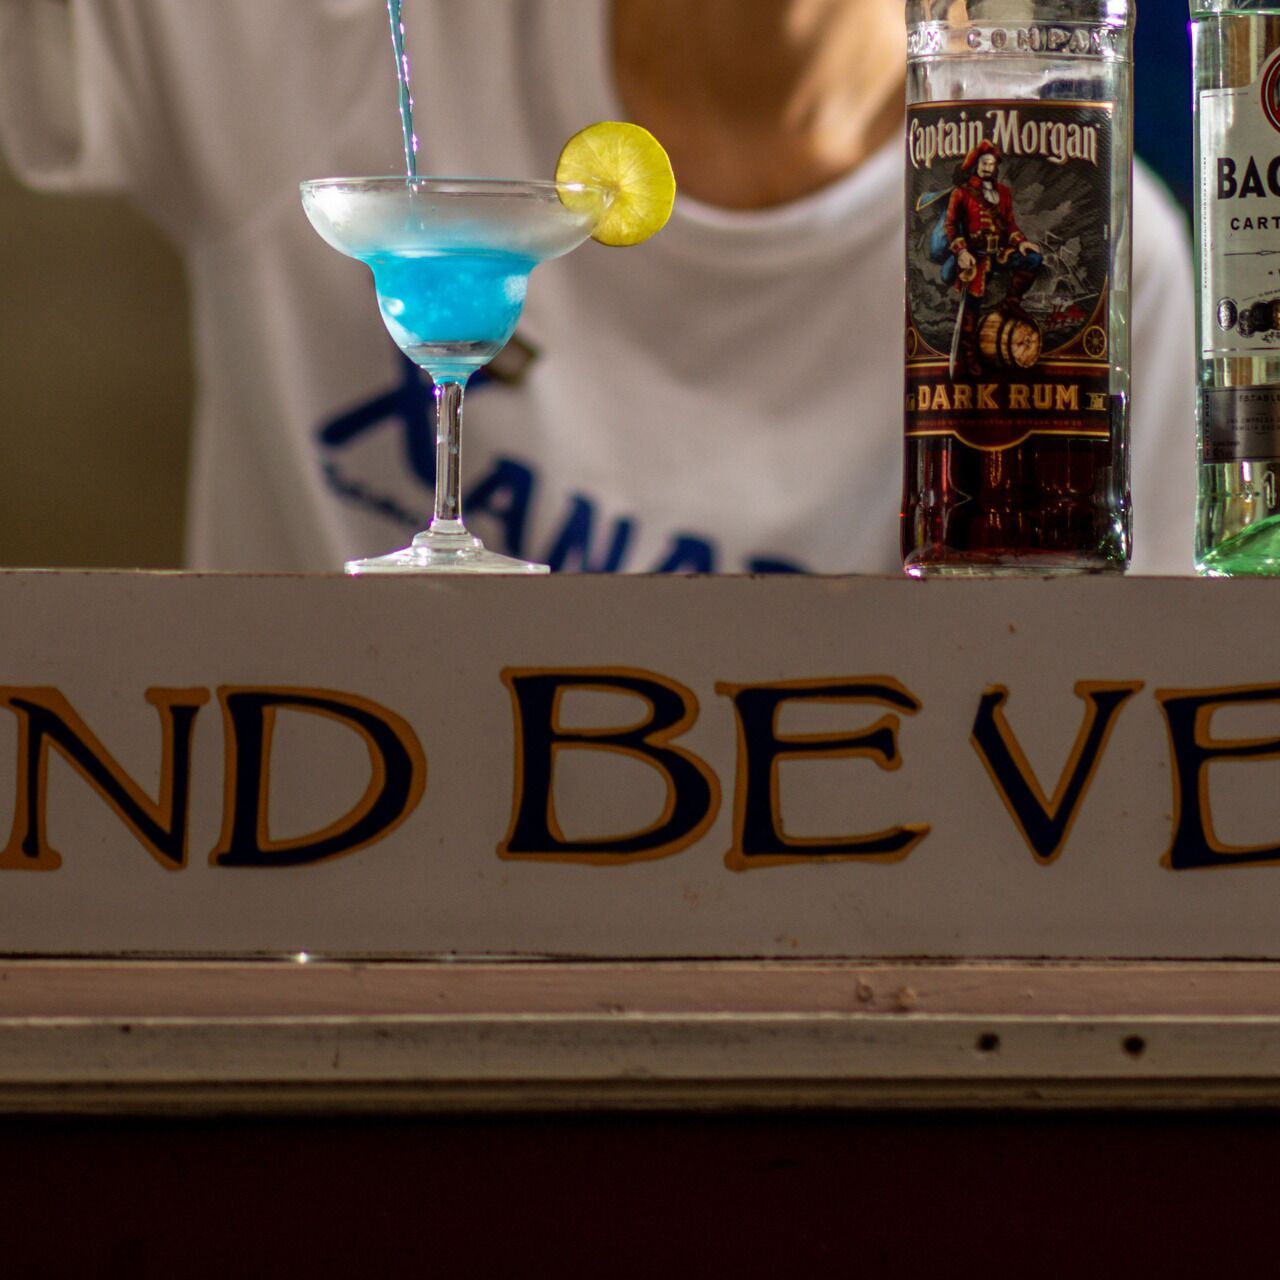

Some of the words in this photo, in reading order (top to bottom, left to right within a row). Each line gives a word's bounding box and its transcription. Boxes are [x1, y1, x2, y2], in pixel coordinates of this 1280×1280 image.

[909, 111, 984, 169] Captain
[985, 109, 1099, 168] Morgan
[917, 383, 1000, 411] DARK
[1008, 383, 1080, 411] RUM
